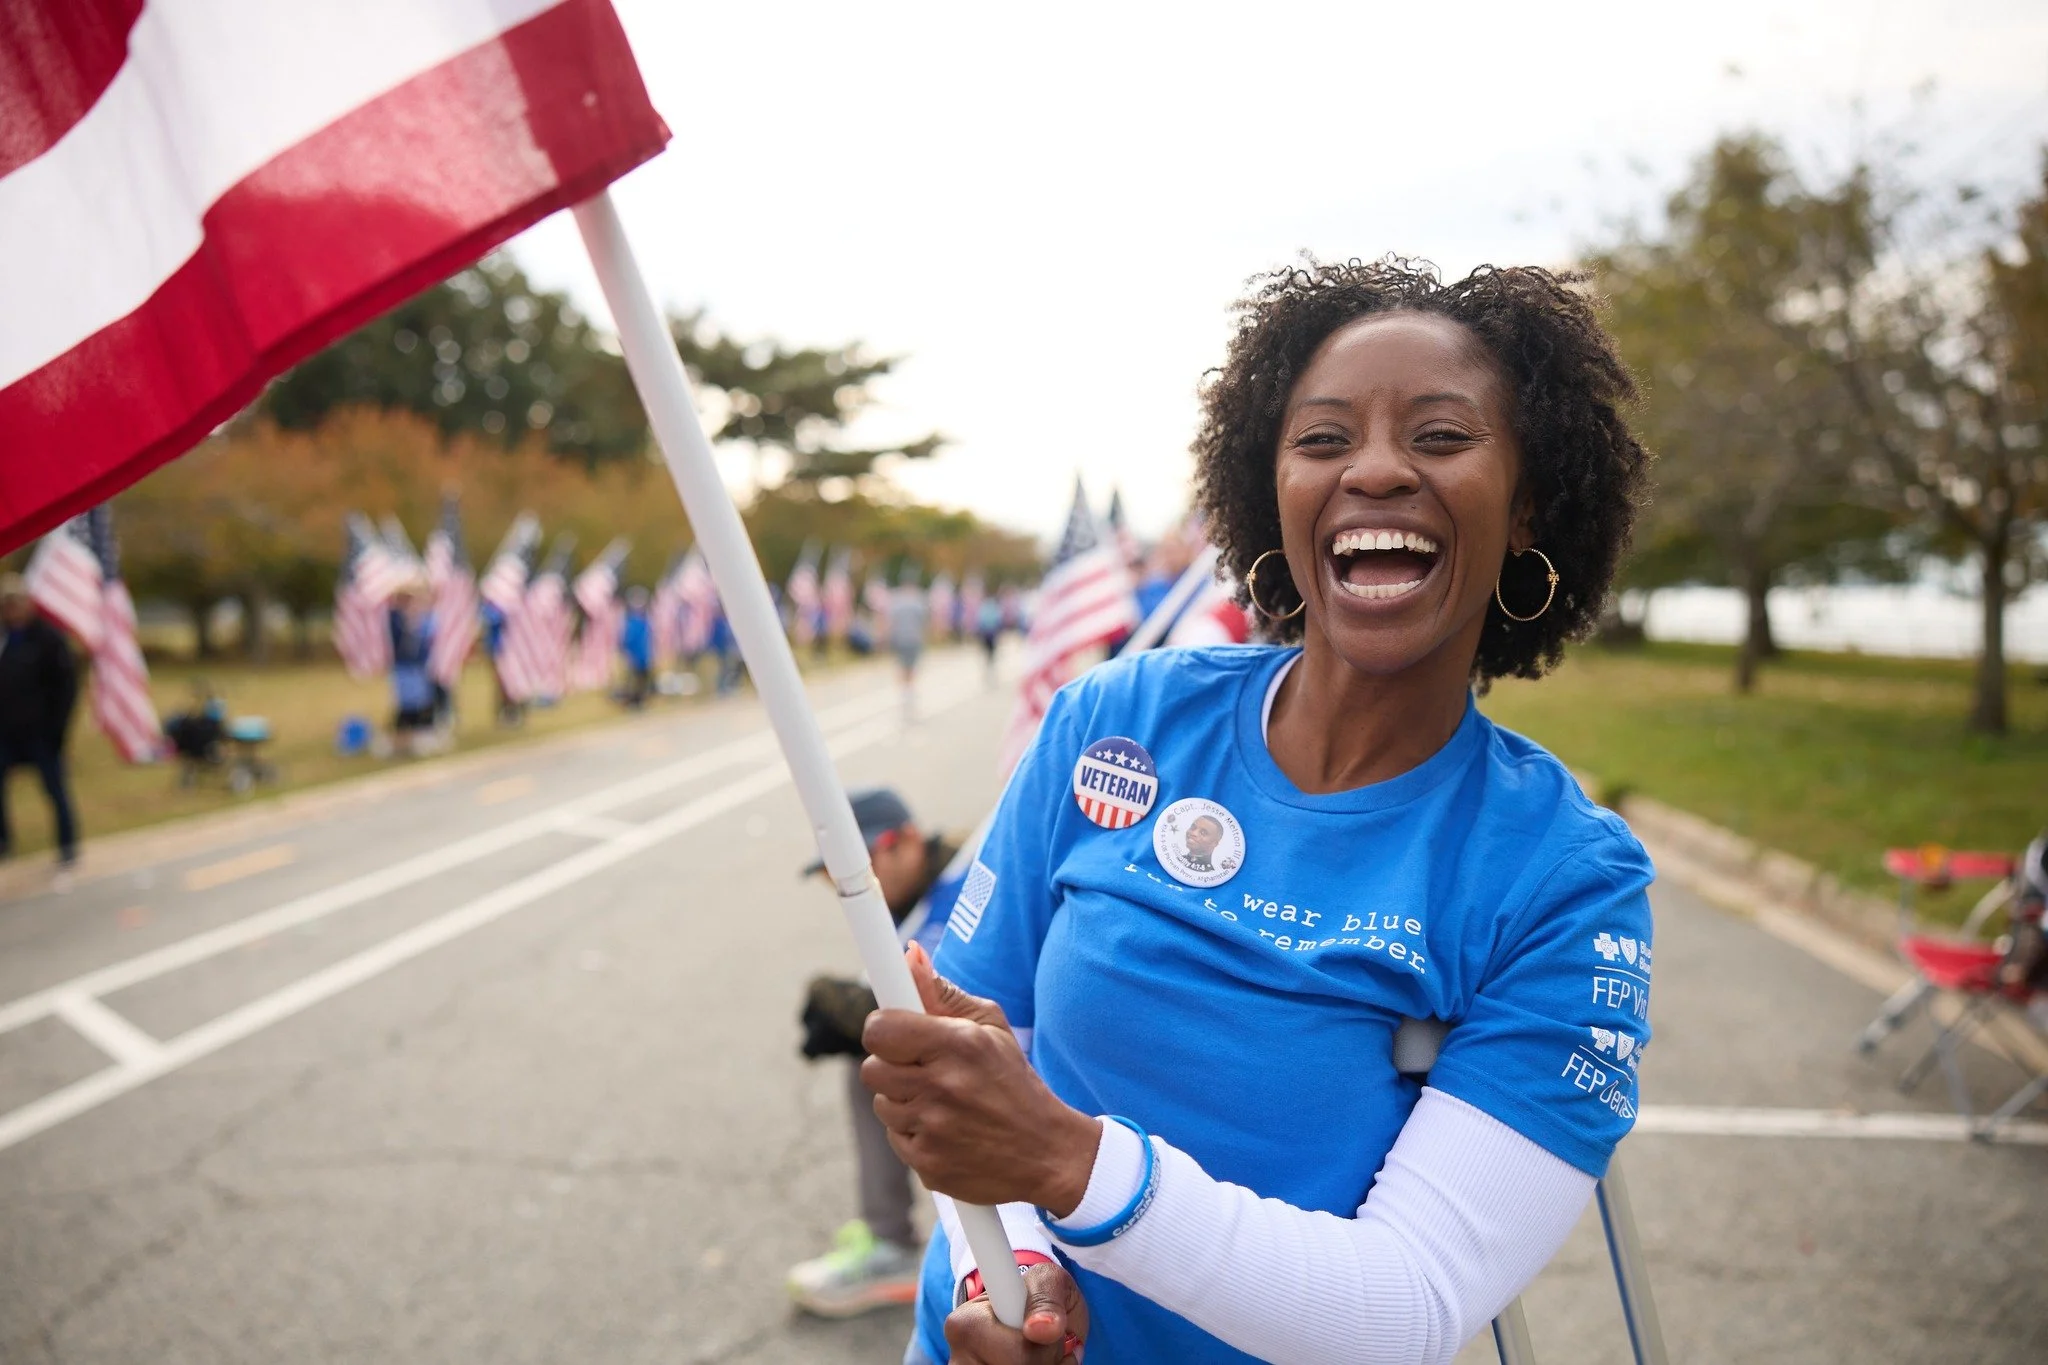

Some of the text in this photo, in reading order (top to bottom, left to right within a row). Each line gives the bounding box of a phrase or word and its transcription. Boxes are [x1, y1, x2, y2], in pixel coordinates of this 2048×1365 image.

[1080, 765, 1152, 807] VETERAN
[1173, 803, 1198, 815] Capt.
[1201, 803, 1225, 818] Jesse
[1223, 816, 1241, 847] Melton
[1203, 897, 1238, 921] to
[1243, 893, 1422, 936] wear blue
[1592, 976, 1631, 1009] FEP
[1561, 1052, 1607, 1093] FEP
